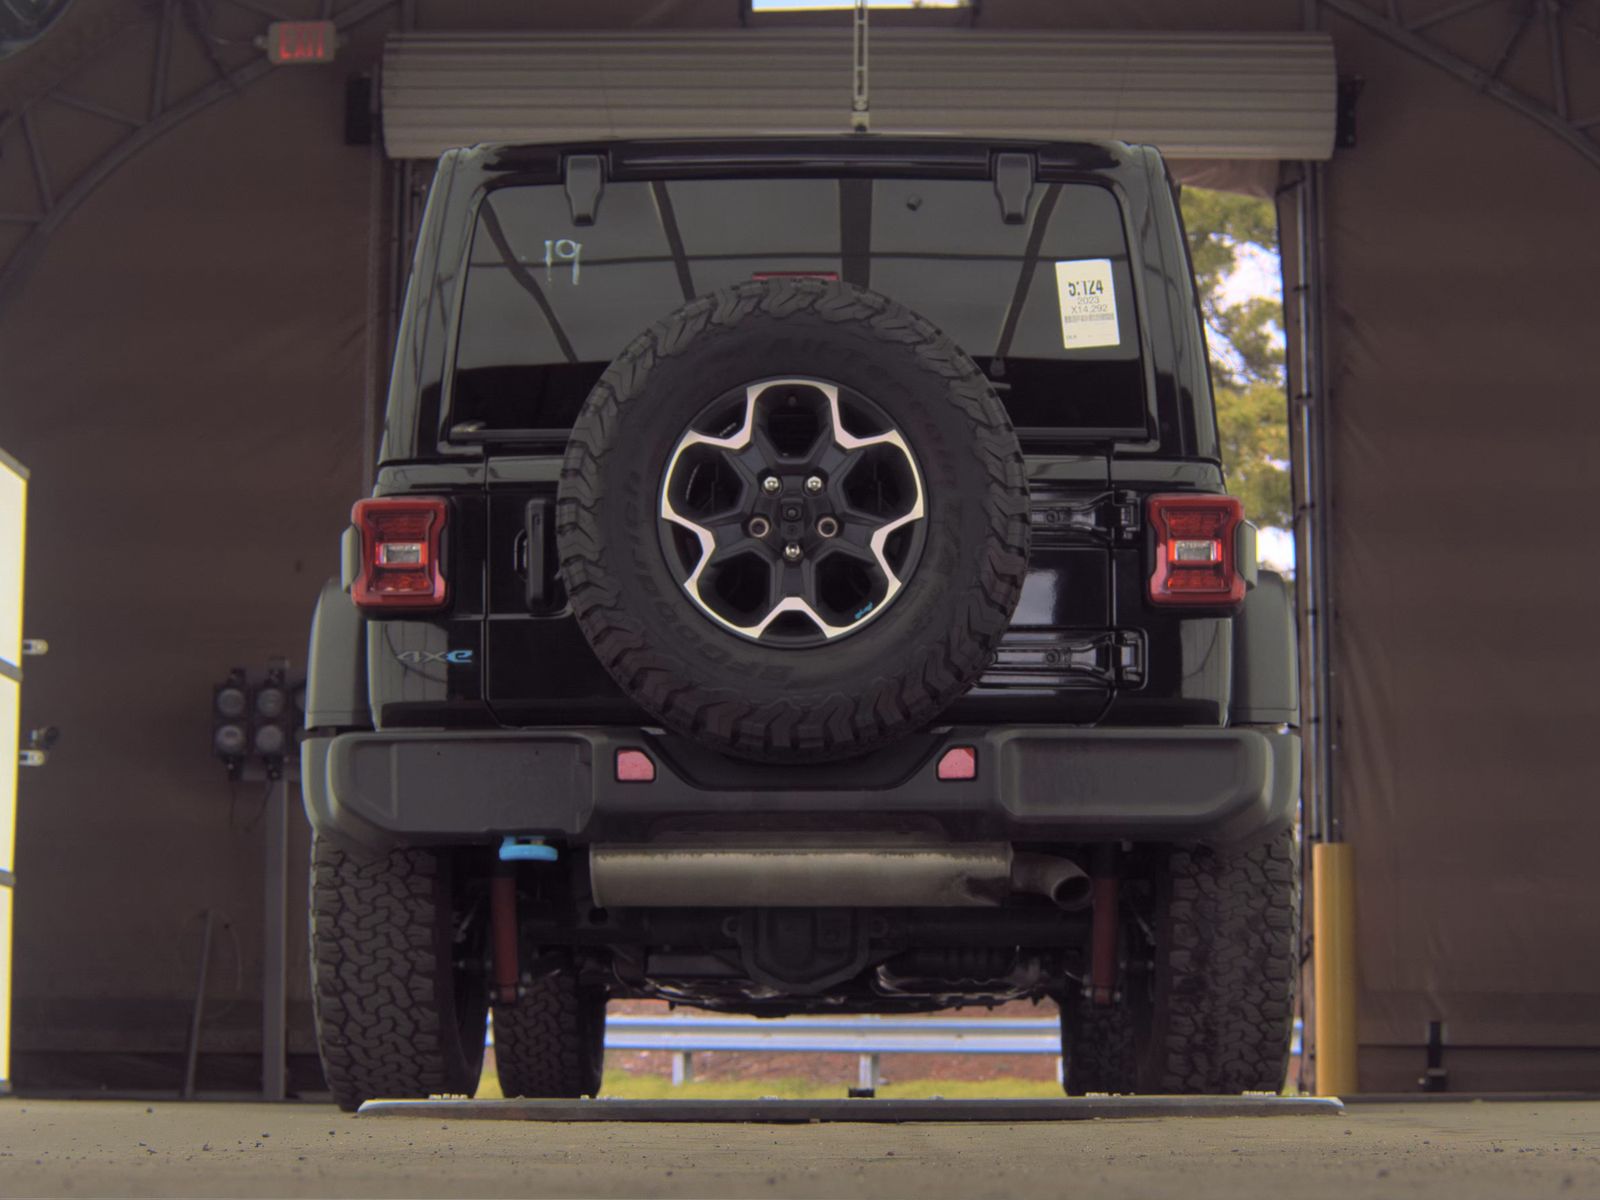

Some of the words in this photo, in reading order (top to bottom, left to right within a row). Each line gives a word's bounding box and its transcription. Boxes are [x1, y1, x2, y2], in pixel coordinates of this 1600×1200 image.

[279, 21, 326, 59] EXIT
[543, 239, 582, 286] 19
[1077, 296, 1100, 305] 2023
